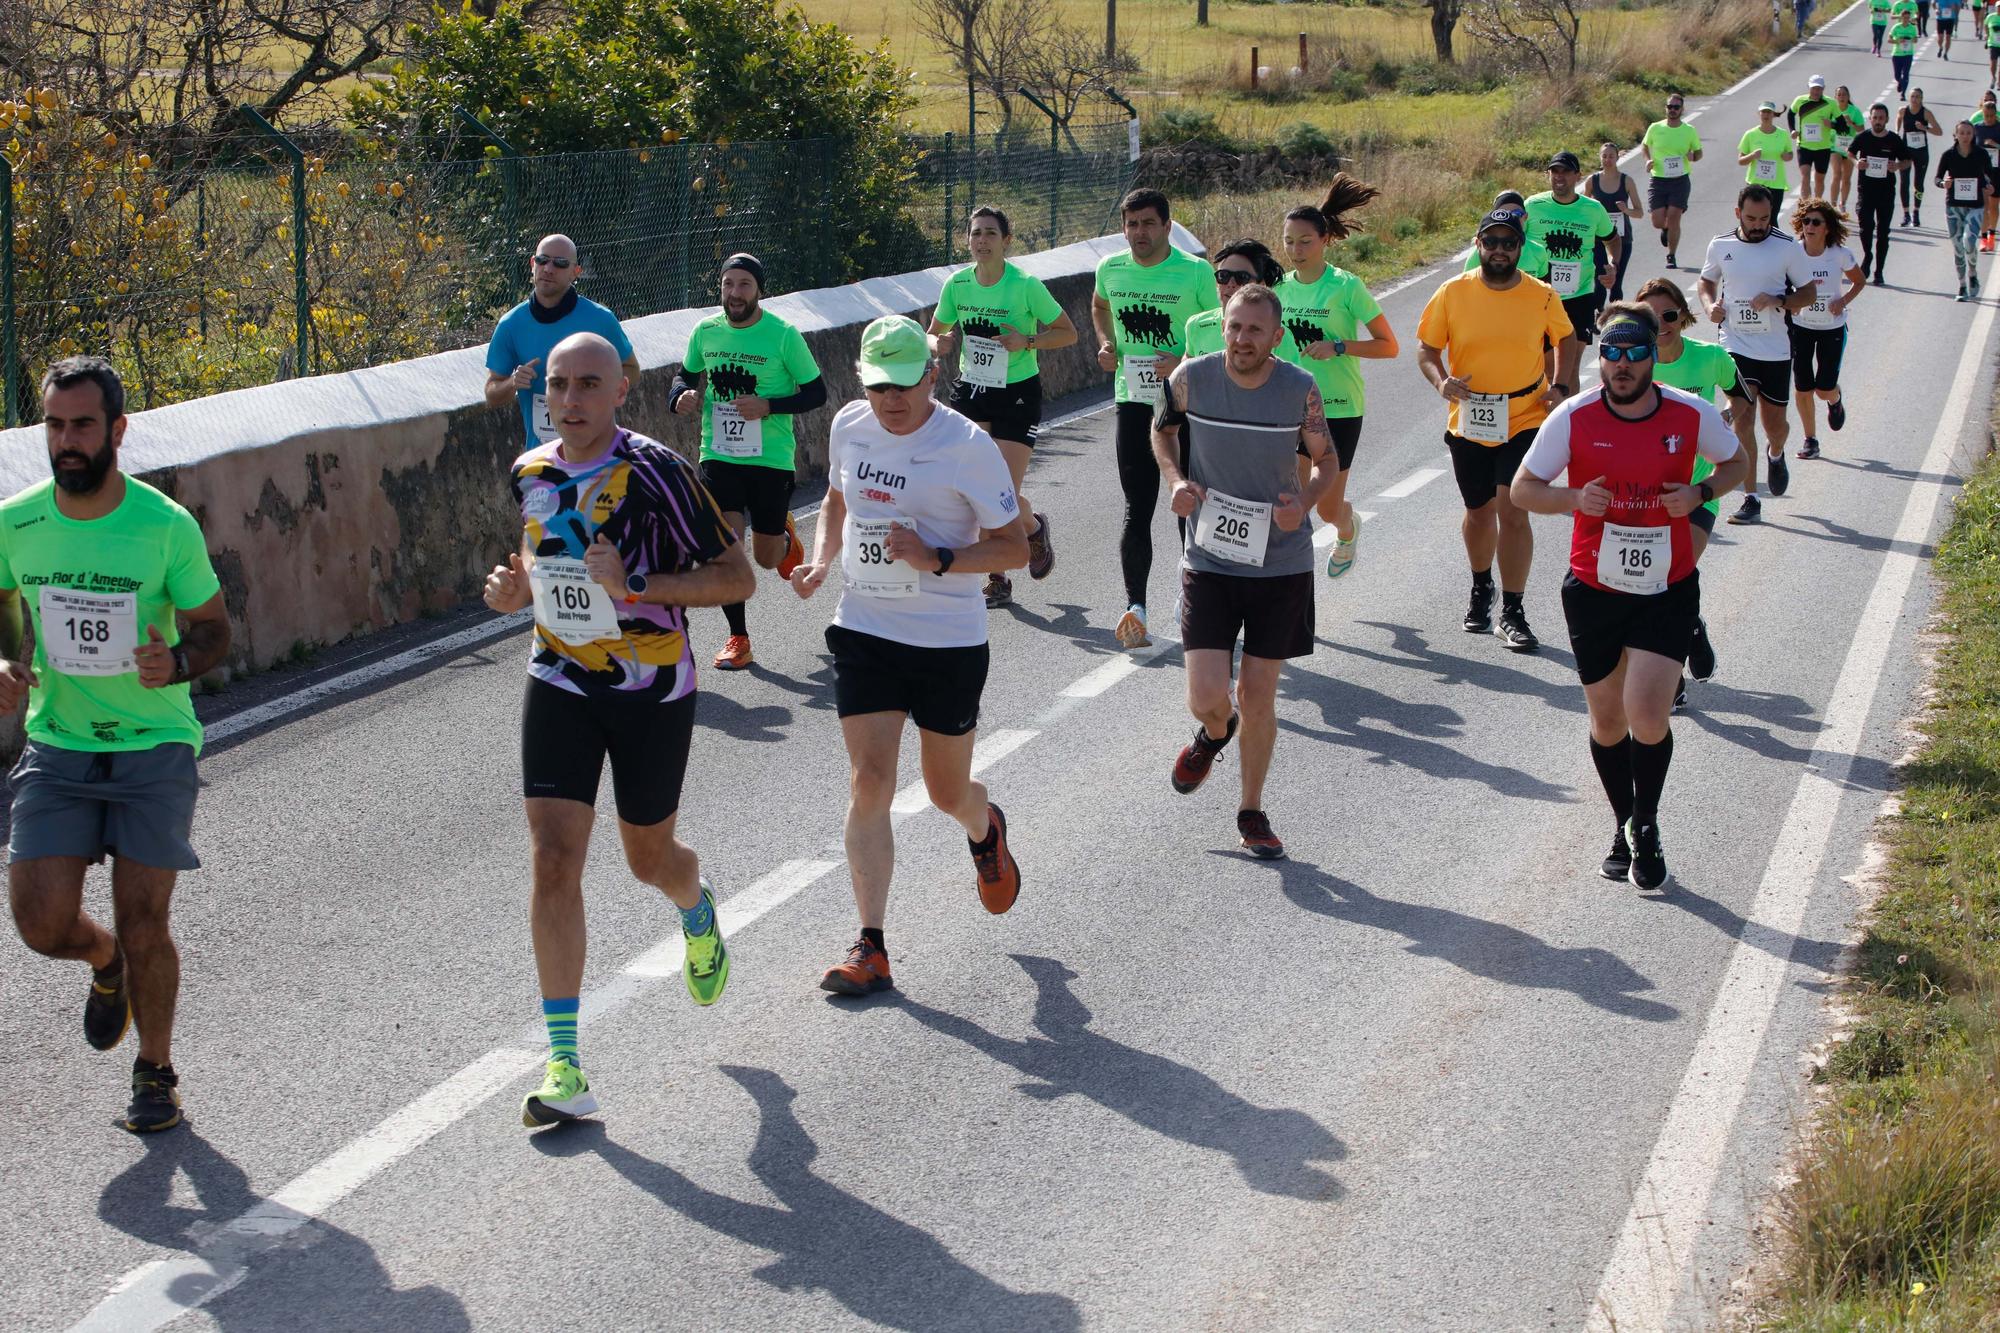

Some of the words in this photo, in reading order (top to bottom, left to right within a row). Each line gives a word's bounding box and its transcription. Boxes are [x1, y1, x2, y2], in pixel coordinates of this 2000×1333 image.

[1959, 184, 1971, 192] 352
[1553, 271, 1571, 282] 378
[1739, 309, 1758, 320] 185
[973, 351, 994, 367] 397
[1471, 408, 1494, 422] 123
[722, 420, 745, 435] 127
[857, 461, 906, 490] U-run
[1215, 515, 1250, 539] 206
[1618, 547, 1652, 568] 186
[22, 573, 49, 586] Cursa
[51, 571, 74, 585] Flor
[1623, 568, 1645, 577] Manuel
[551, 585, 591, 610] 160
[557, 610, 572, 621] David
[65, 617, 110, 643] 168
[78, 643, 99, 655] Fran
